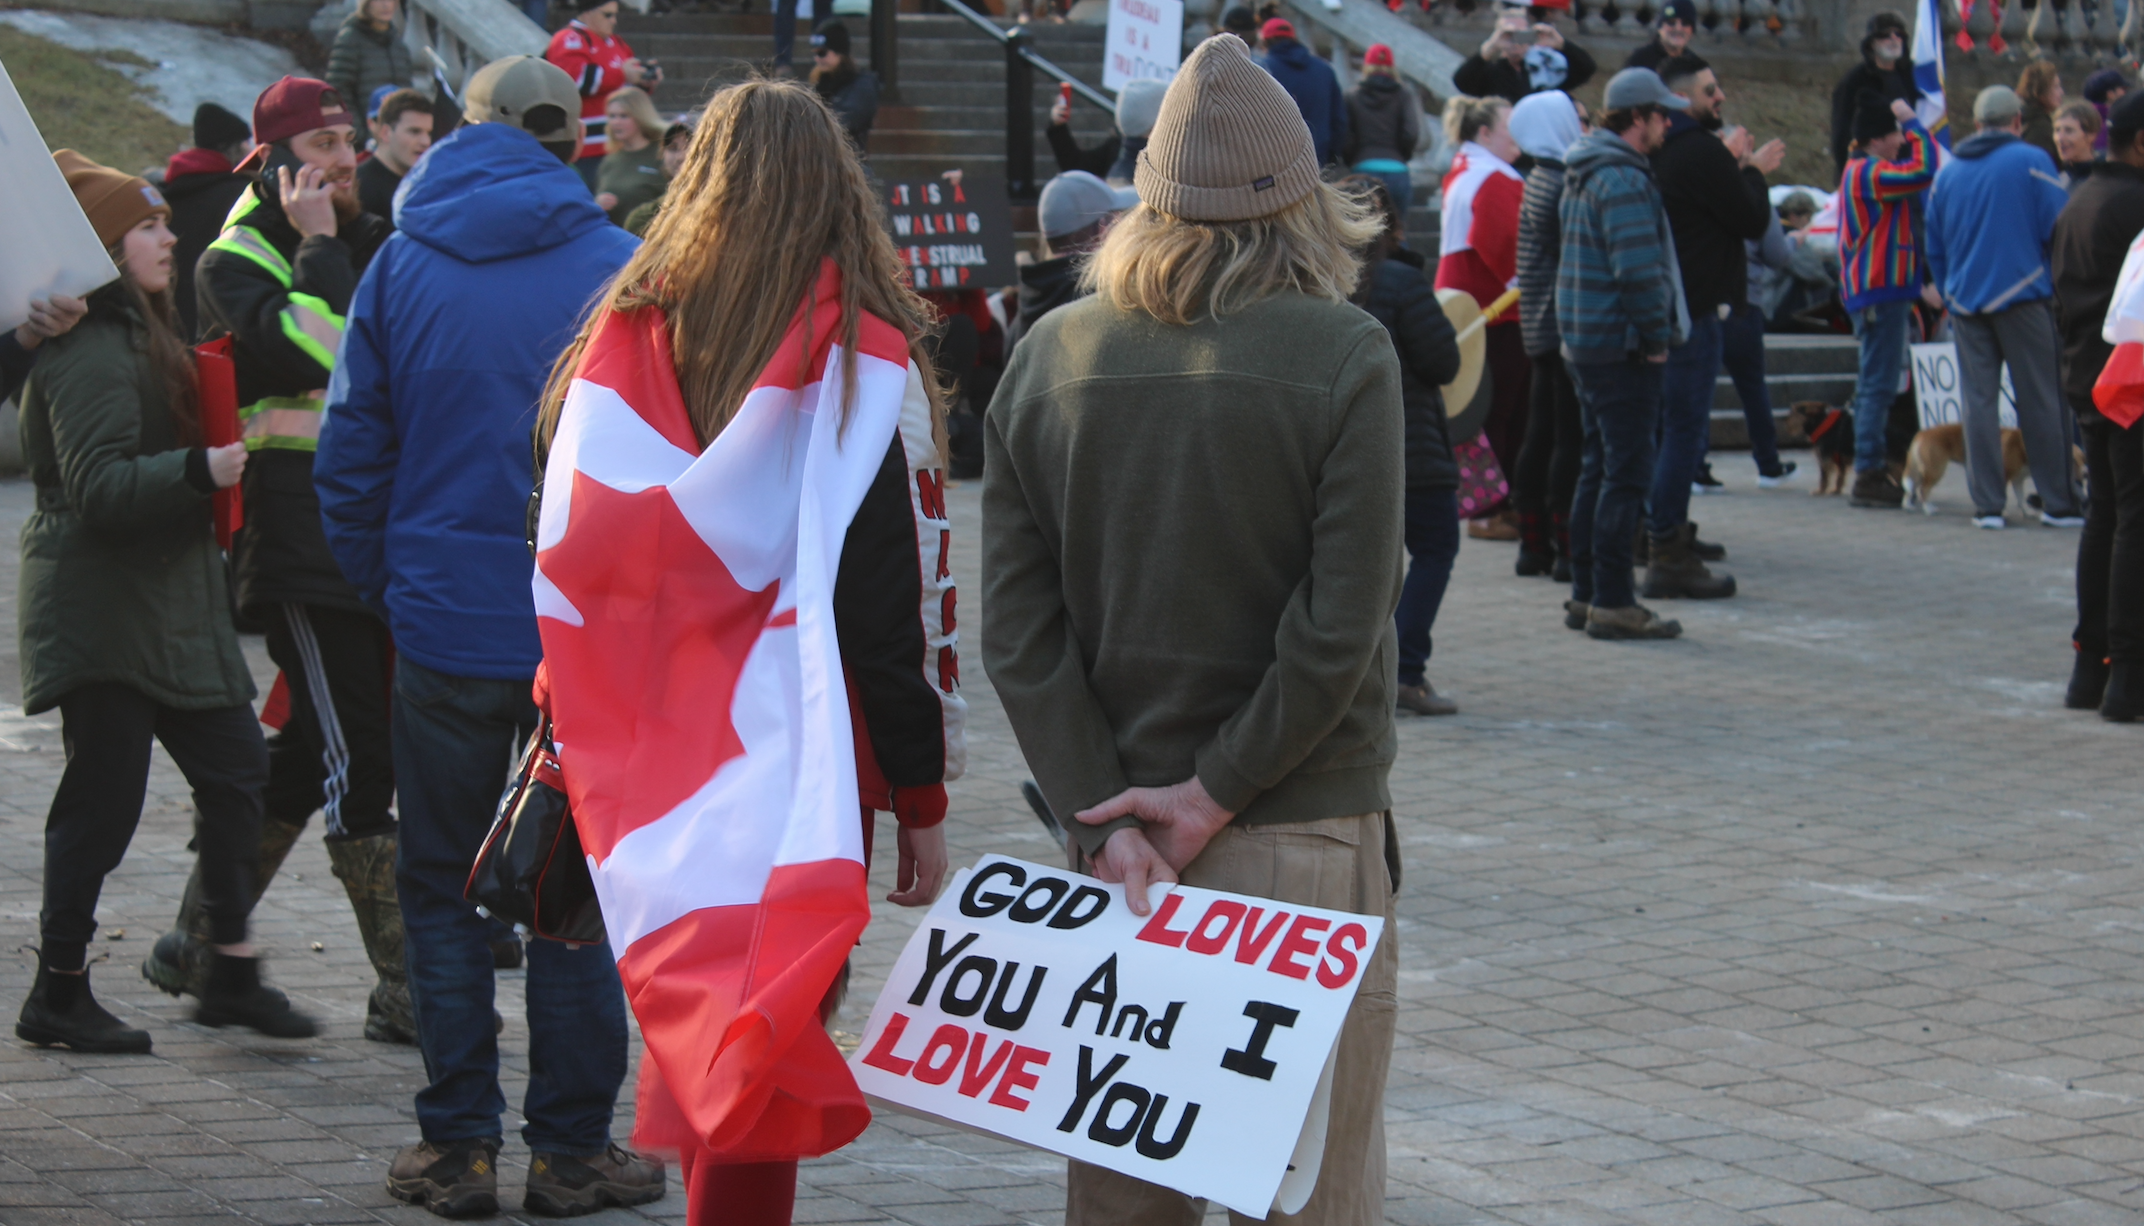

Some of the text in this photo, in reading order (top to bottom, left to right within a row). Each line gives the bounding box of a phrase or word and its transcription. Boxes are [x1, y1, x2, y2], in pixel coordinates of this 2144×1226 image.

[920, 182, 942, 205] IS
[954, 184, 966, 203] A
[893, 212, 980, 235] WALKING
[897, 245, 987, 266] MENSTRUAL
[1916, 355, 1956, 393] NO
[959, 862, 1367, 989] GOD LOVES
[1061, 952, 1187, 1050] And
[1220, 1000, 1300, 1081] I
[862, 1012, 1051, 1112] LOVE
